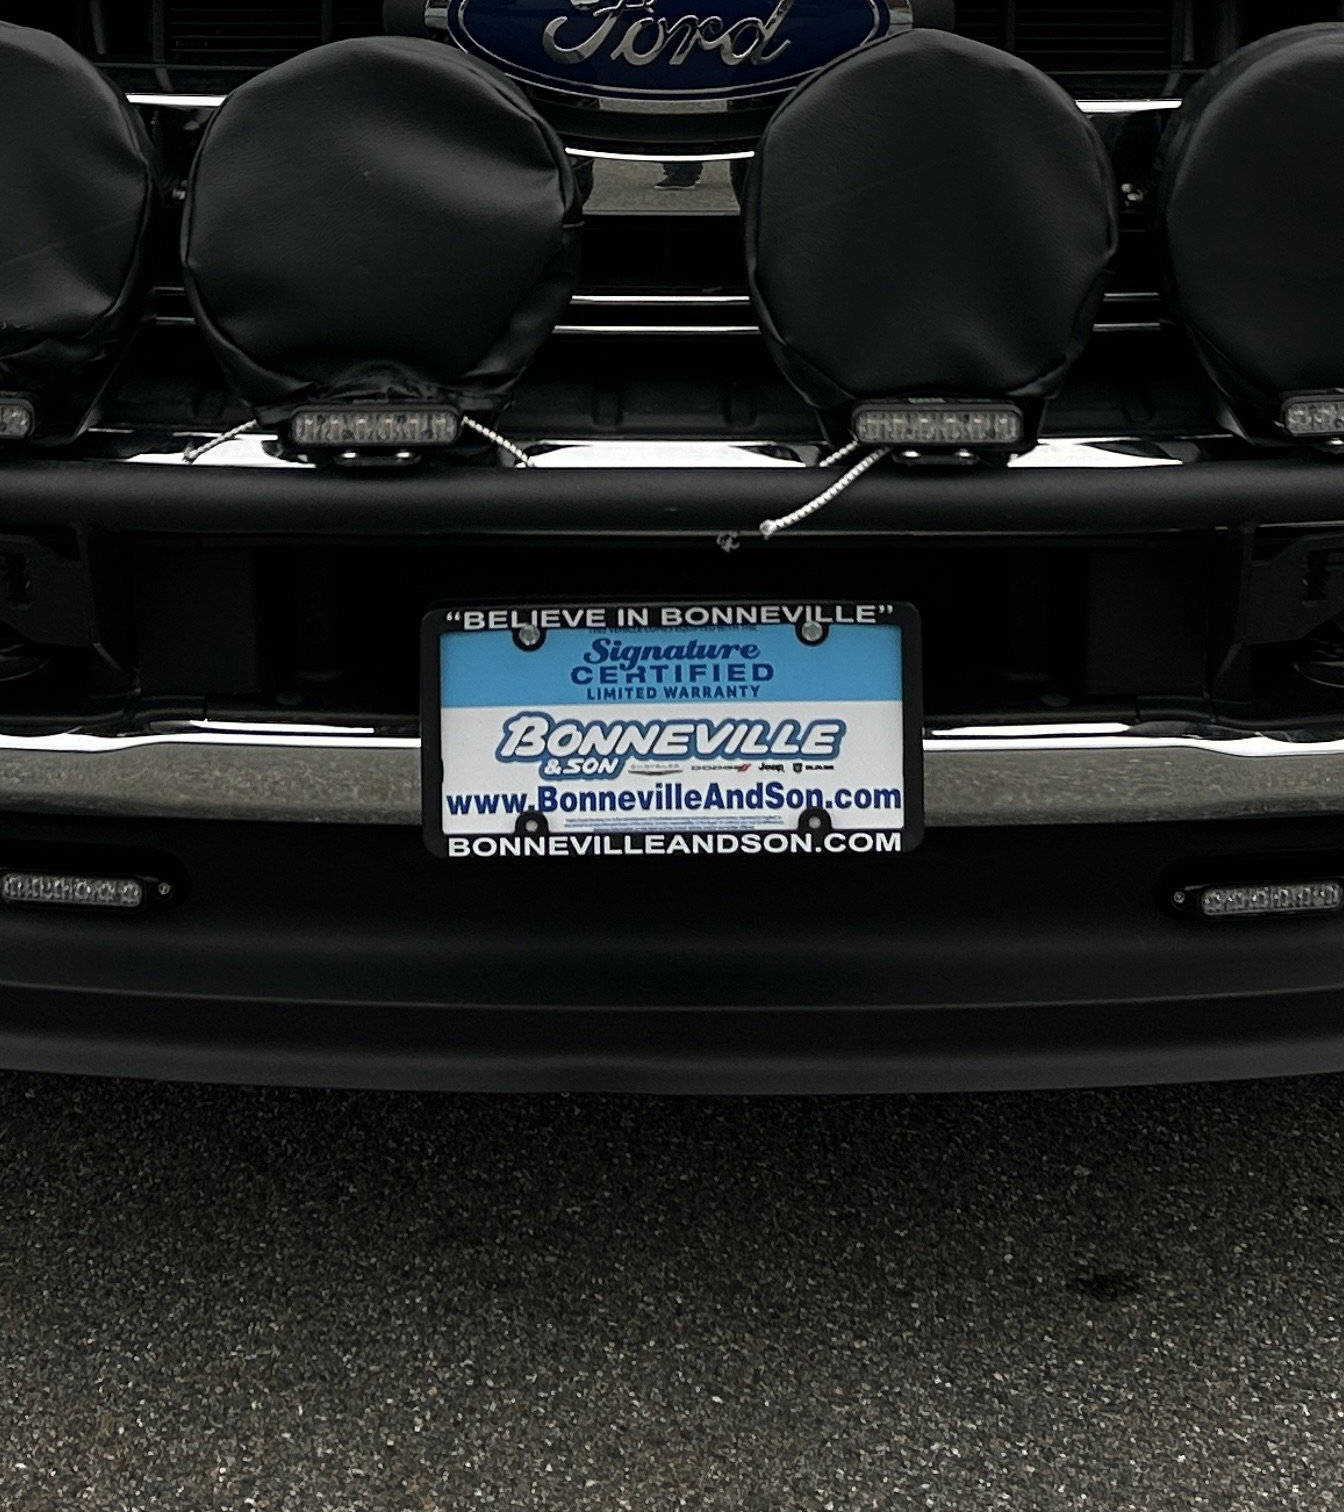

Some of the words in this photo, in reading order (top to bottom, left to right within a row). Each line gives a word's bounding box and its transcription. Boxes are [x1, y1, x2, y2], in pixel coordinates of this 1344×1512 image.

[617, 608, 649, 627] IN
[583, 637, 761, 670] Signature
[571, 663, 774, 685] CERTIFIED
[587, 687, 657, 701] LIMITED
[664, 685, 760, 700] WARRANTY
[498, 714, 842, 759] BONNEVILLE
[446, 781, 901, 815] www.BonnevilleAndSon.com
[448, 832, 901, 857] BONNEVILLEANDSON.COM
